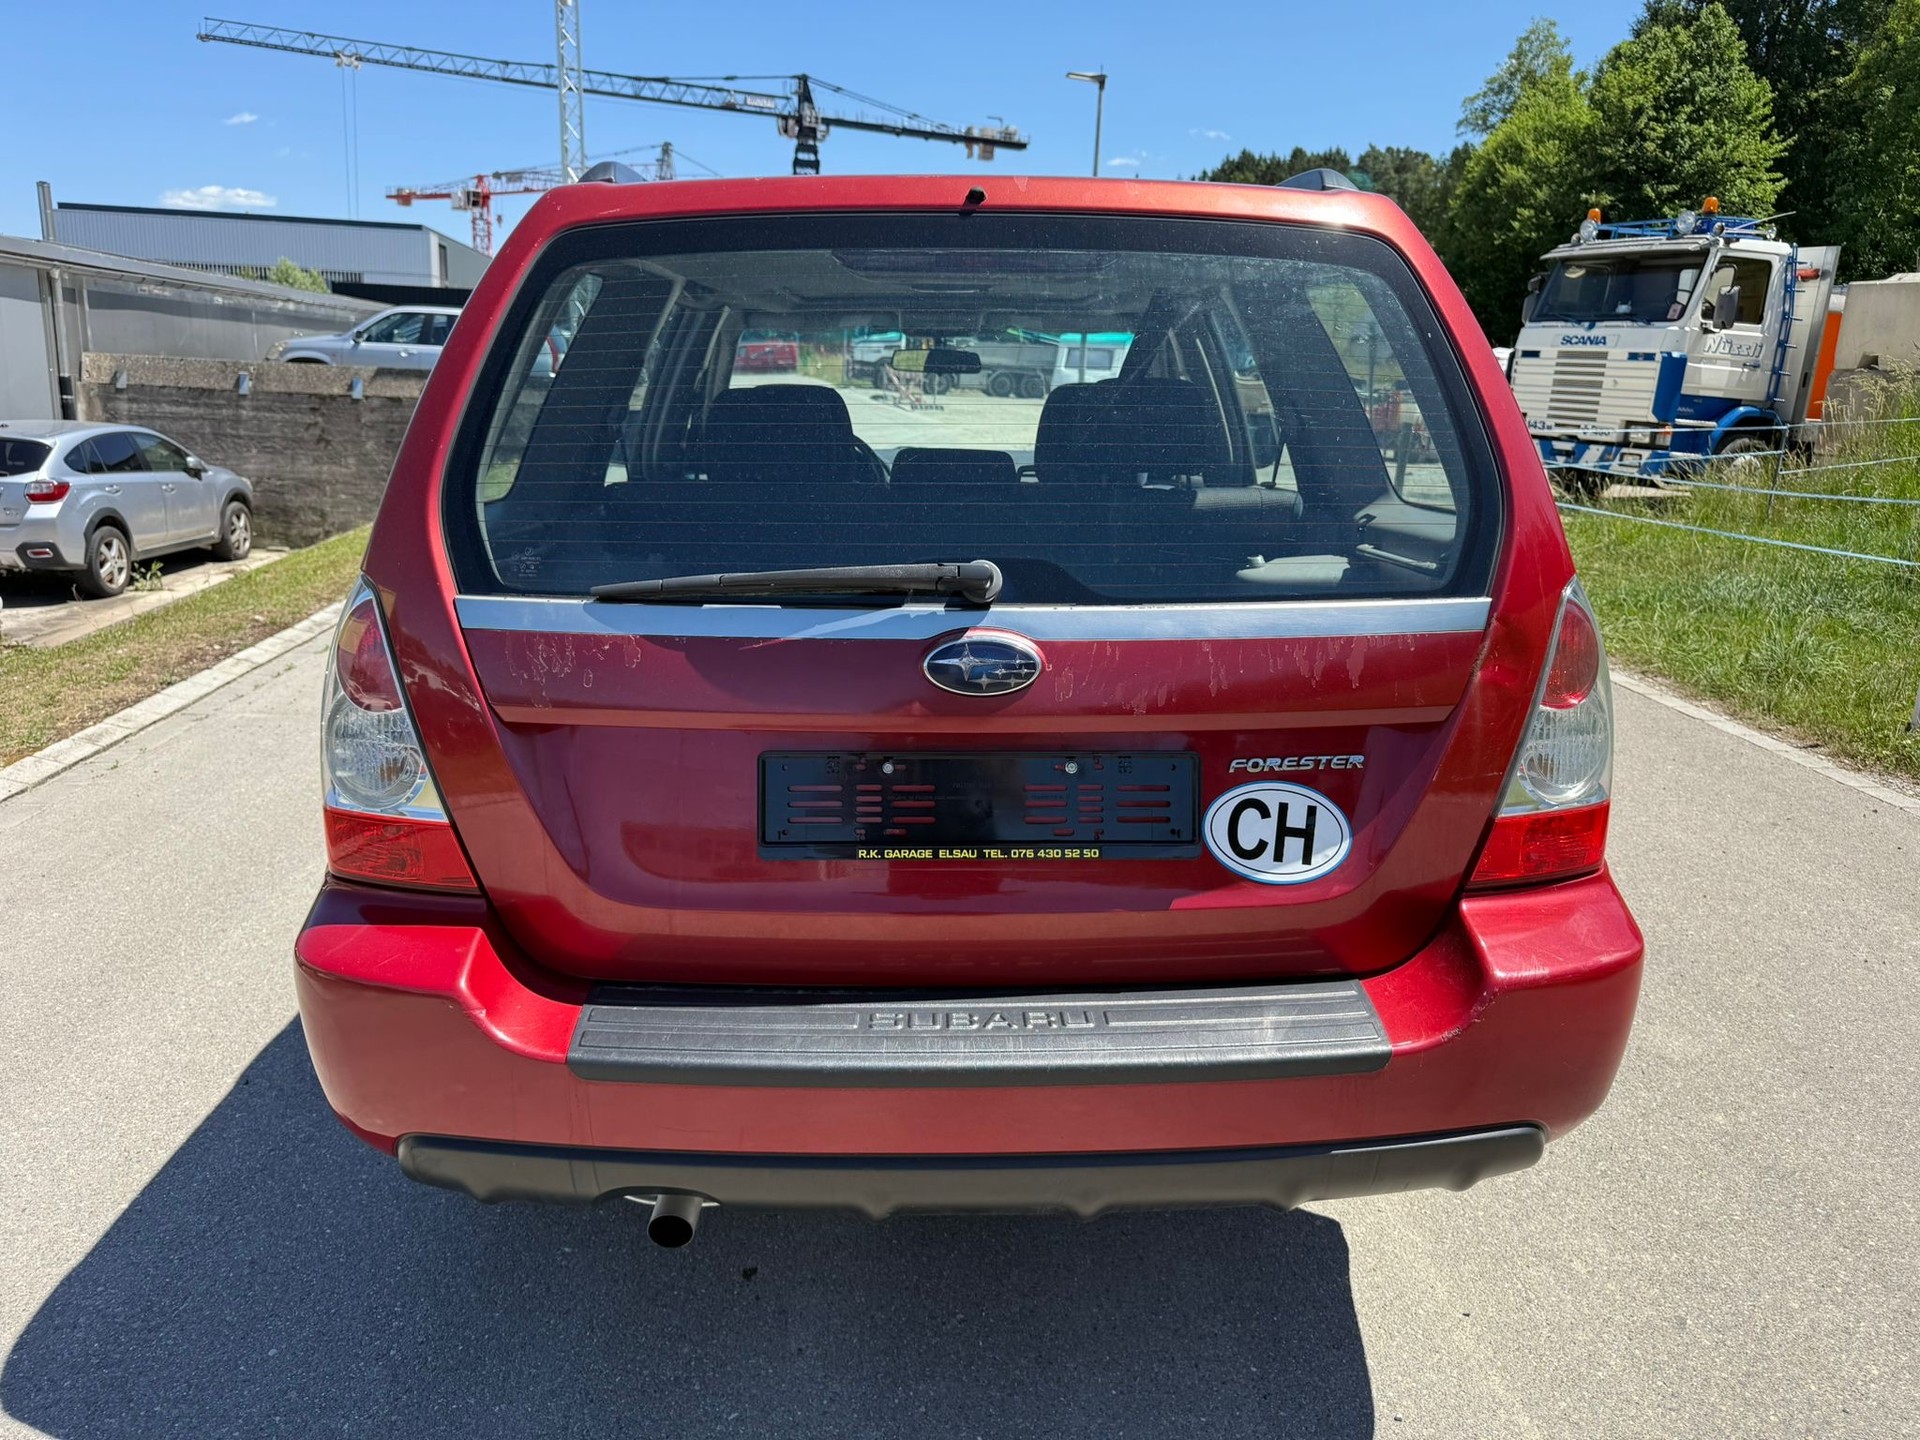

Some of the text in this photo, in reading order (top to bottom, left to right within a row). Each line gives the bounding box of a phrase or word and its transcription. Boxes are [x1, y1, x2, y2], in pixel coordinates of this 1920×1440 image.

[1561, 335, 1607, 346] SCANIA
[1703, 334, 1764, 358] Nüssli
[1228, 754, 1365, 774] FORESTER
[1227, 797, 1318, 866] CH
[858, 849, 1100, 859] R.K. GARAGE ELSAU TEL. 076 430 52 50
[869, 1010, 1095, 1030] SUBARU
